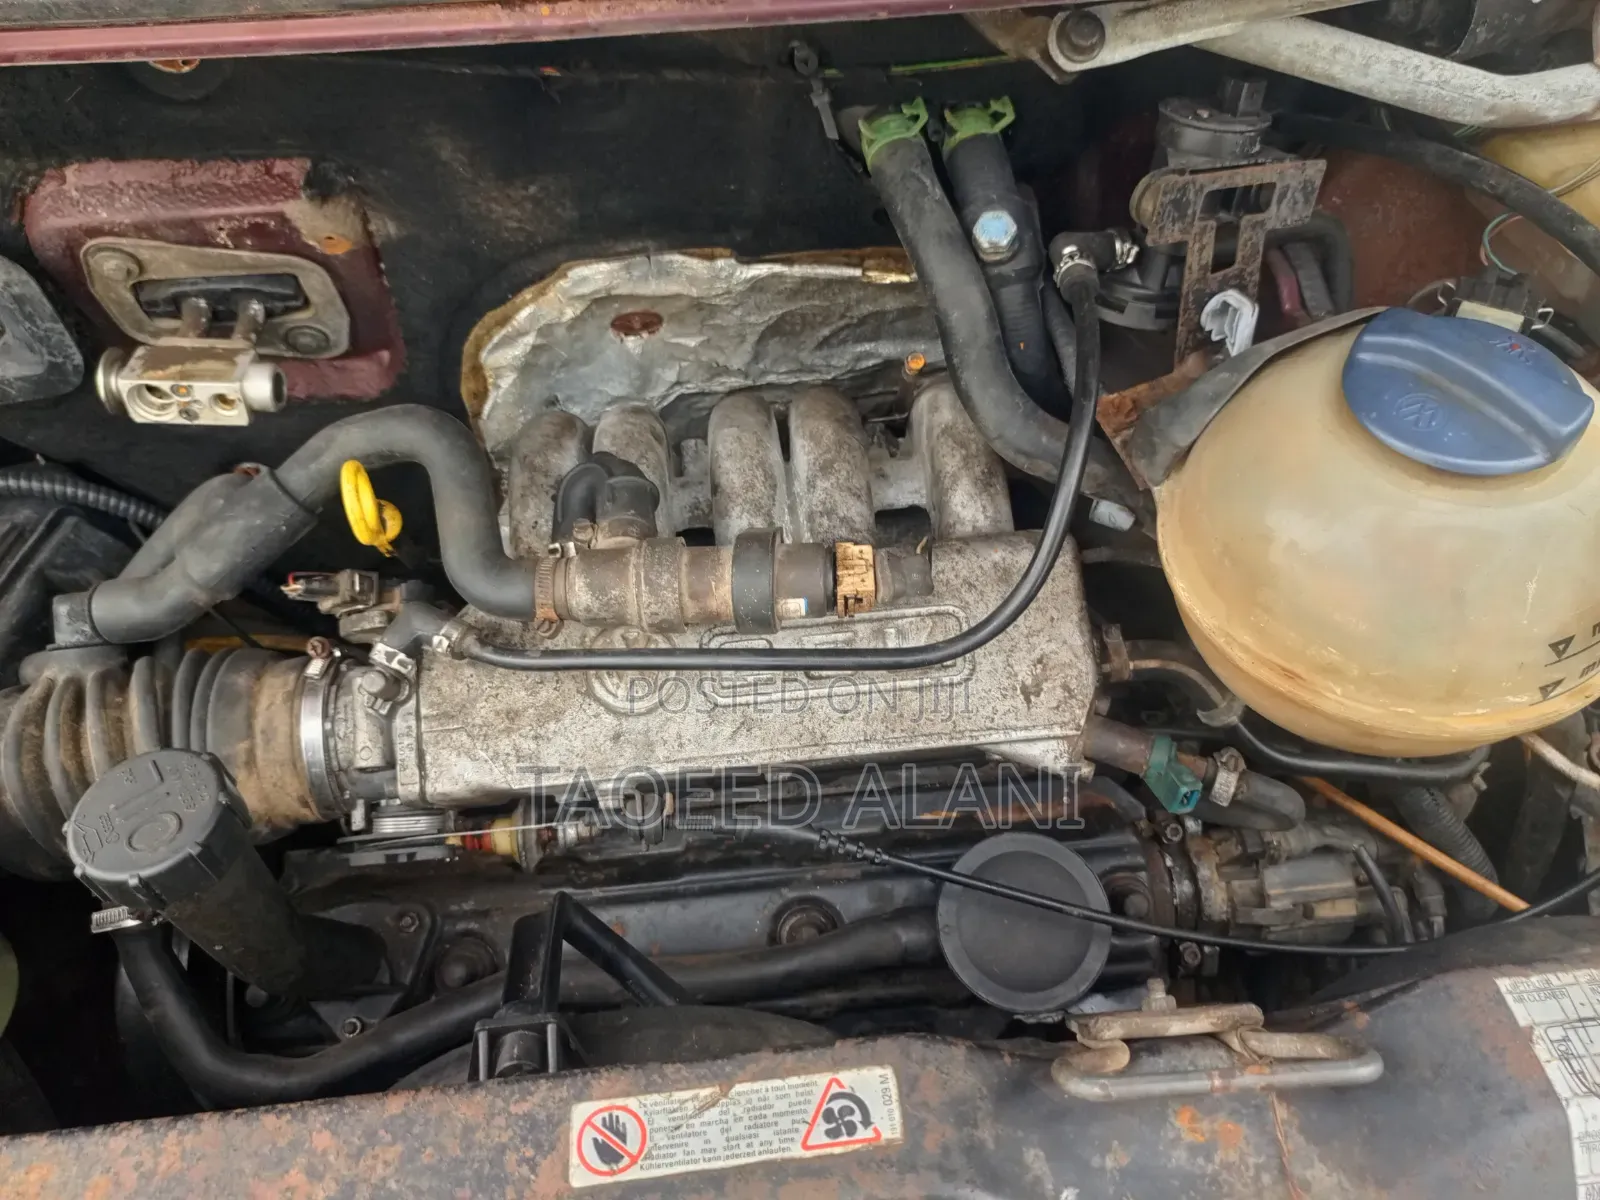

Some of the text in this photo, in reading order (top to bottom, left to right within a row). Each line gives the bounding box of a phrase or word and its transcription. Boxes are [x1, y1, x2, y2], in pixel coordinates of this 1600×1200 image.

[878, 1073, 890, 1085] M
[775, 1092, 791, 1100] som
[881, 1087, 893, 1106] 029
[718, 1107, 730, 1116] del
[743, 1103, 775, 1113] radiador
[788, 1098, 812, 1108] puede
[699, 1117, 729, 1127] marcha
[748, 1112, 767, 1121] cada
[666, 1129, 708, 1141] ventilatore
[744, 1120, 779, 1131] radiatore
[725, 1132, 760, 1143] qualsiasi
[683, 1148, 695, 1157] fan
[700, 1146, 717, 1155] may
[722, 1142, 741, 1152] start
[746, 1141, 754, 1149] at
[759, 1139, 773, 1148] any
[639, 1157, 701, 1172] Kühlerventilator
[702, 1153, 722, 1164] kann
[723, 1150, 756, 1162] jederzeit
